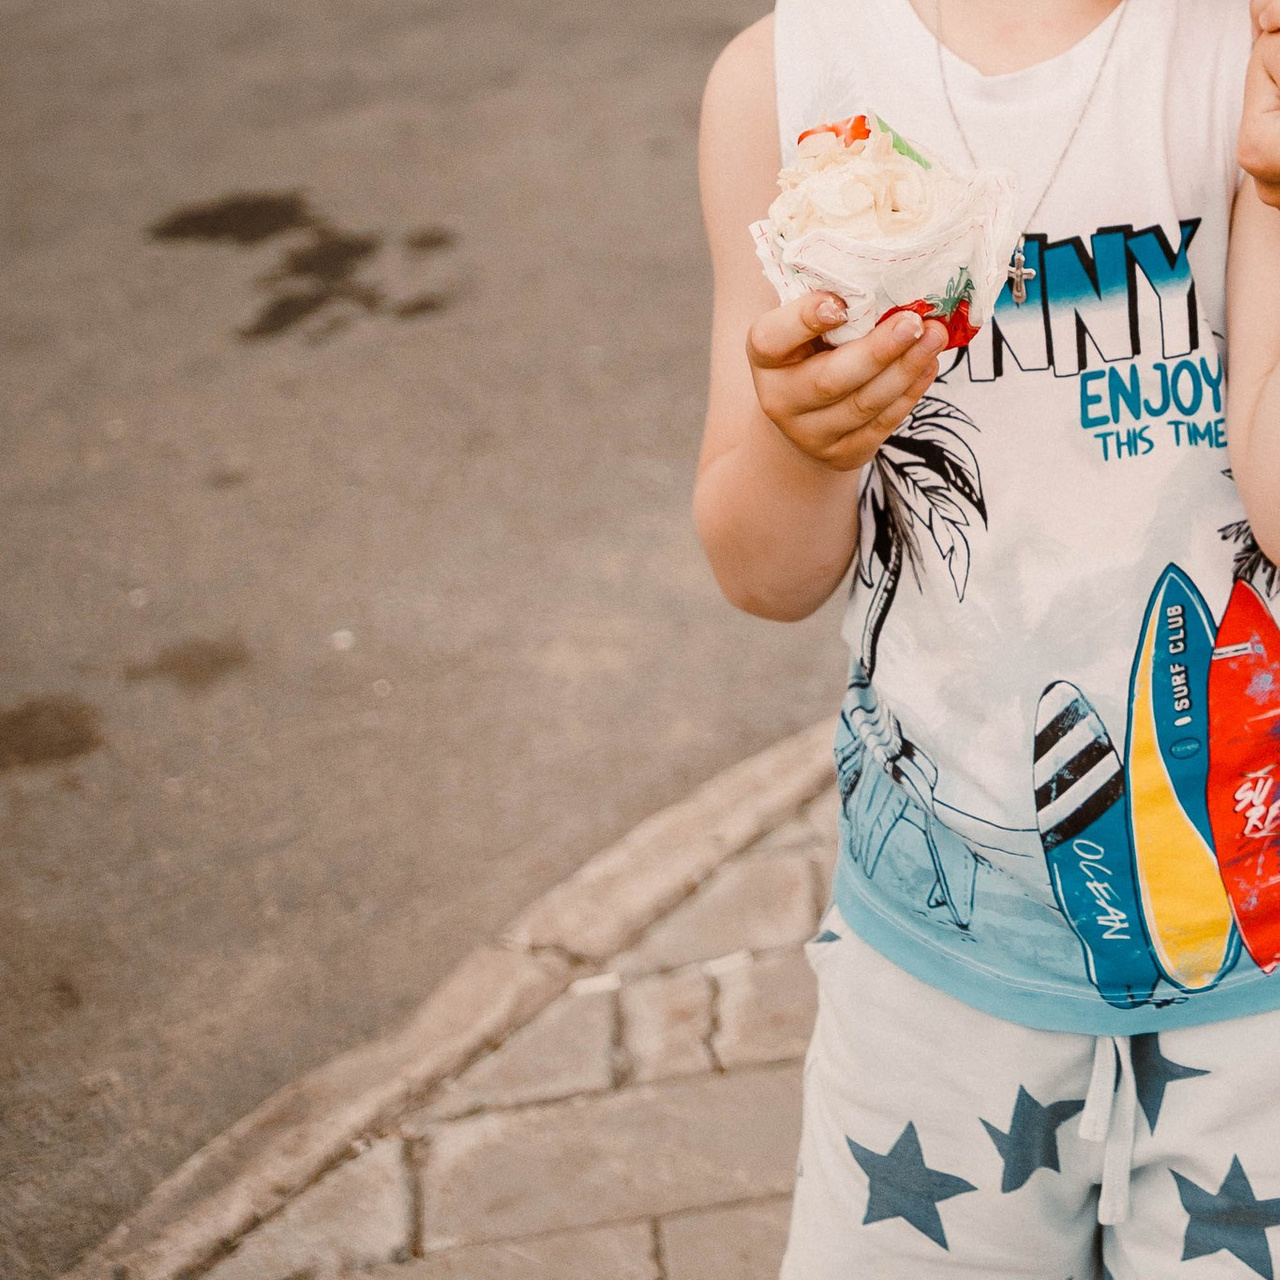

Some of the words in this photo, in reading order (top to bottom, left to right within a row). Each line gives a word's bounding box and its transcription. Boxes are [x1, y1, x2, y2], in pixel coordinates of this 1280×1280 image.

[934, 217, 1202, 383] NNY
[1080, 357, 1223, 429] ENJOY
[1095, 425, 1154, 462] THIS
[1167, 418, 1228, 448] TIME
[1166, 604, 1186, 655] CLUB
[1170, 663, 1192, 713] SURF
[1072, 839, 1132, 940] OCEAN
